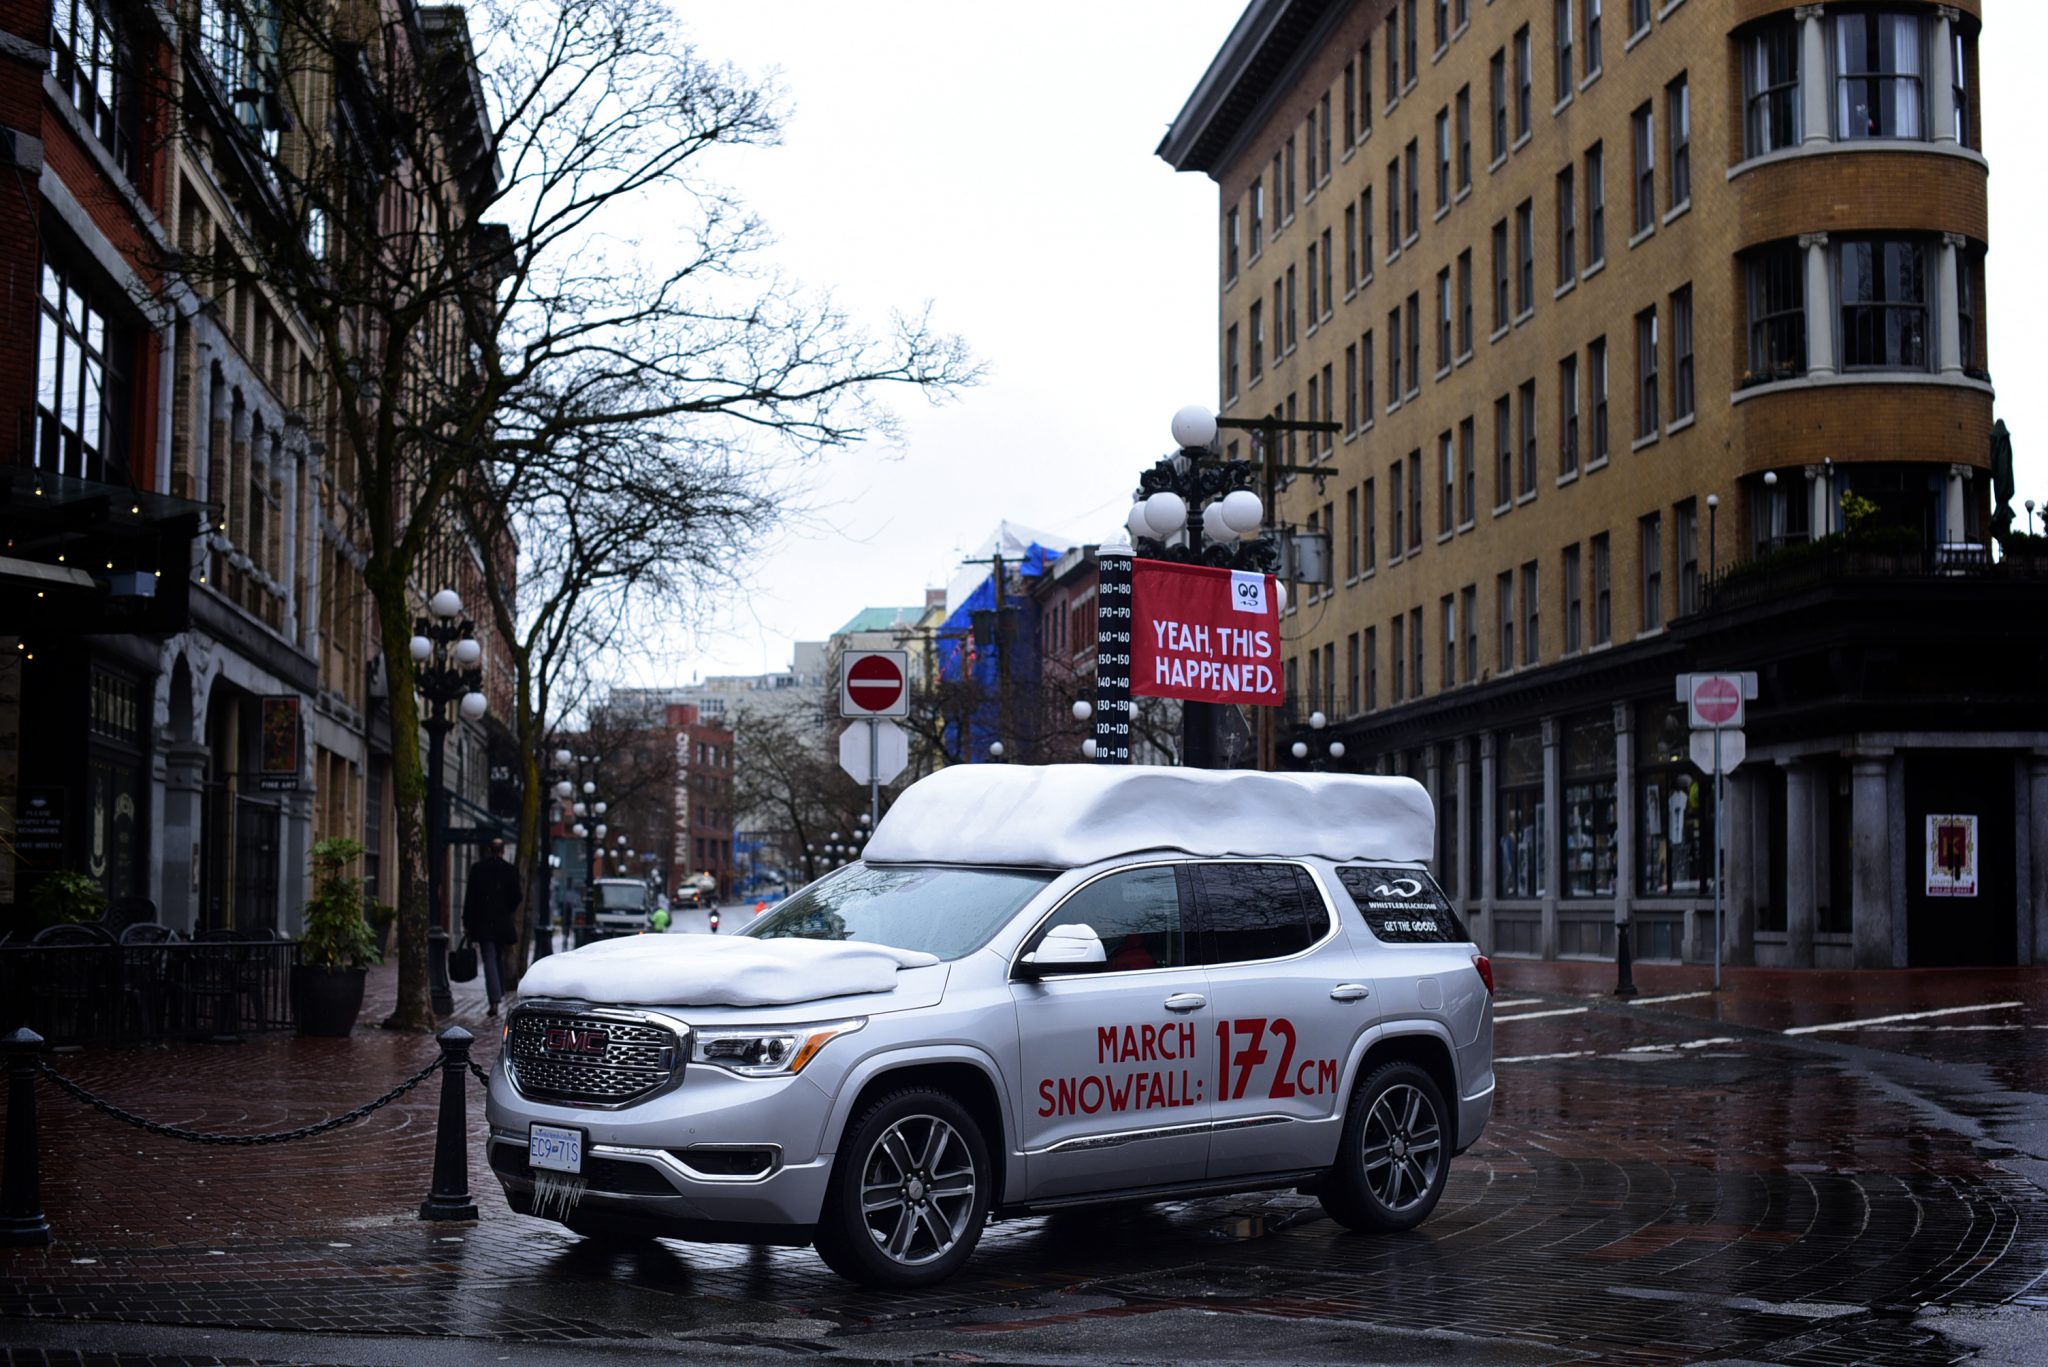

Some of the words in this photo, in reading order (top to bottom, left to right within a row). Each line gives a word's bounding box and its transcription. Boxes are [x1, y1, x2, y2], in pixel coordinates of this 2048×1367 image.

[1153, 620, 1213, 658] YEAH,
[1216, 628, 1272, 658] THIS
[1155, 656, 1277, 694] HAPPENED.
[1384, 921, 1398, 931] GET
[1398, 921, 1411, 931] THE
[1412, 921, 1437, 931] GOODS
[547, 1029, 605, 1054] GMC
[1098, 1022, 1195, 1064] MARCH
[1038, 1070, 1203, 1118] SNOWFALL:
